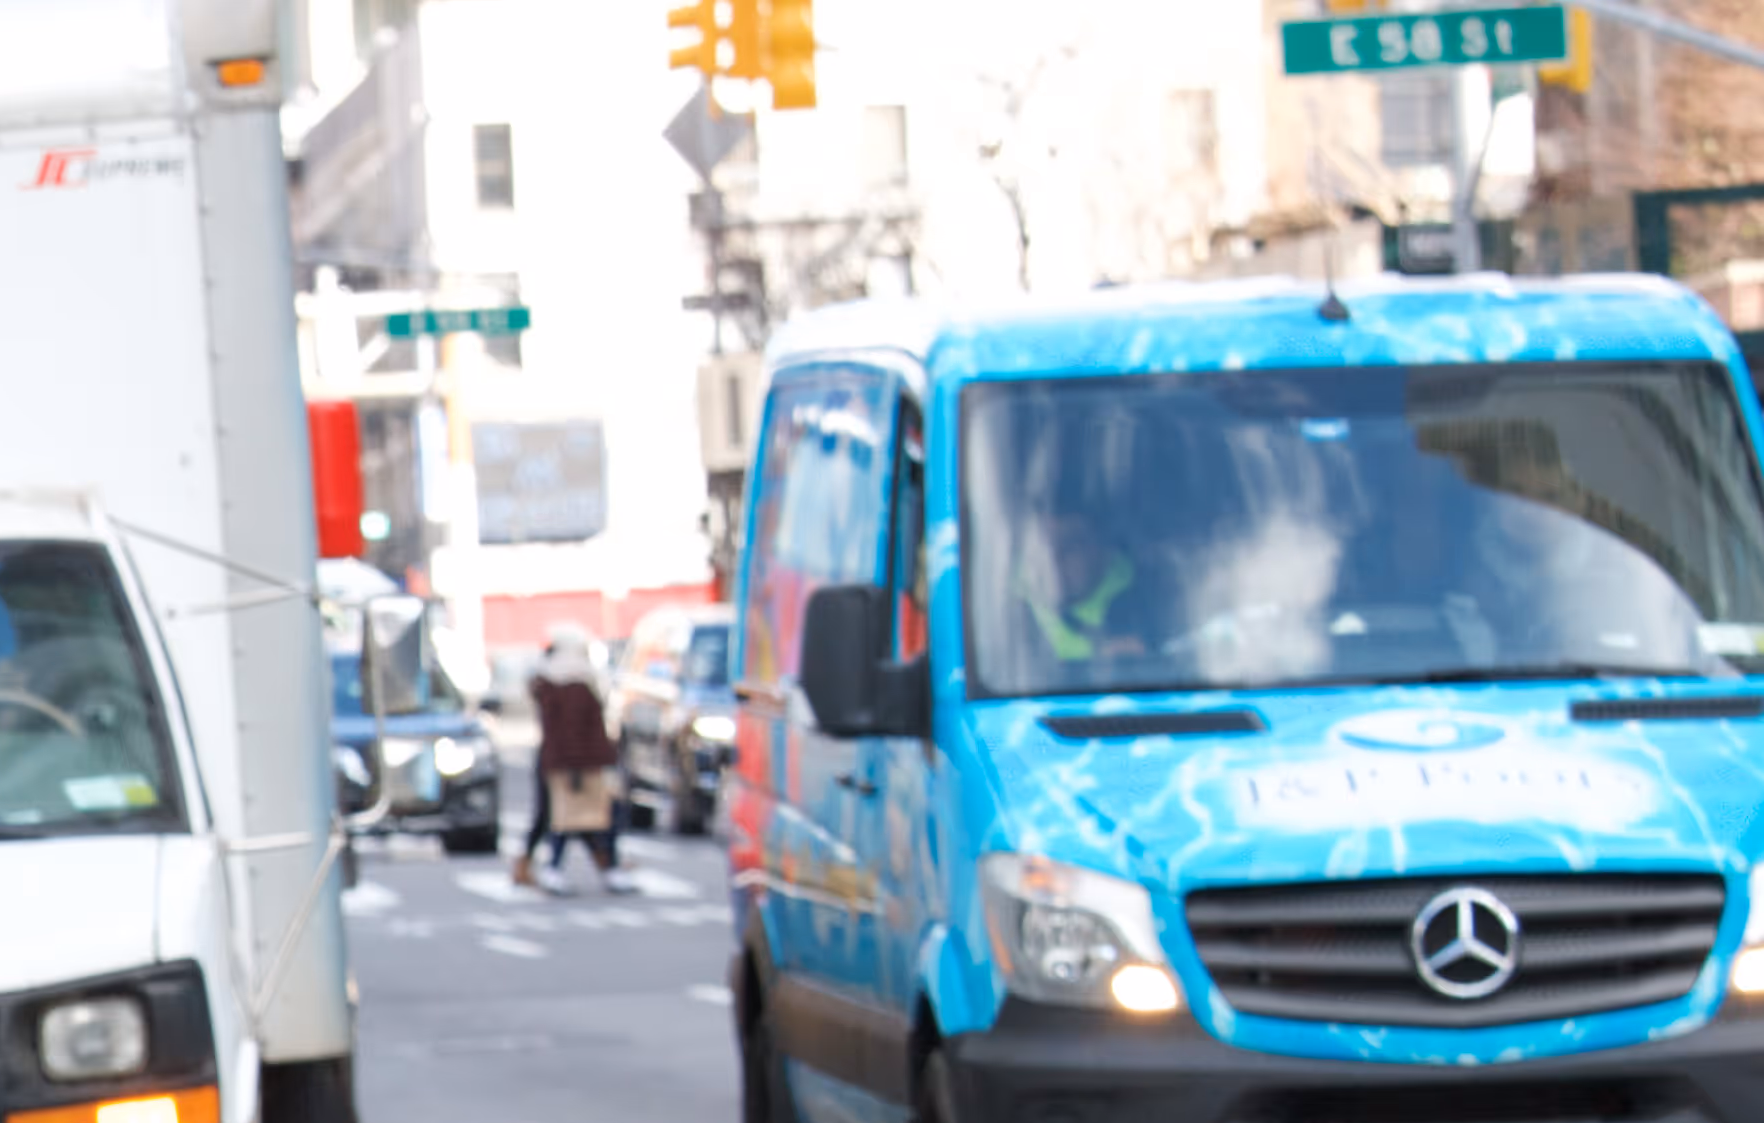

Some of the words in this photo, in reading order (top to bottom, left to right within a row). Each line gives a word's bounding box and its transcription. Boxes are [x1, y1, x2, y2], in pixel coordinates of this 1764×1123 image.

[1330, 24, 1361, 66] E
[1378, 20, 1443, 63] 58
[1460, 16, 1513, 58] St
